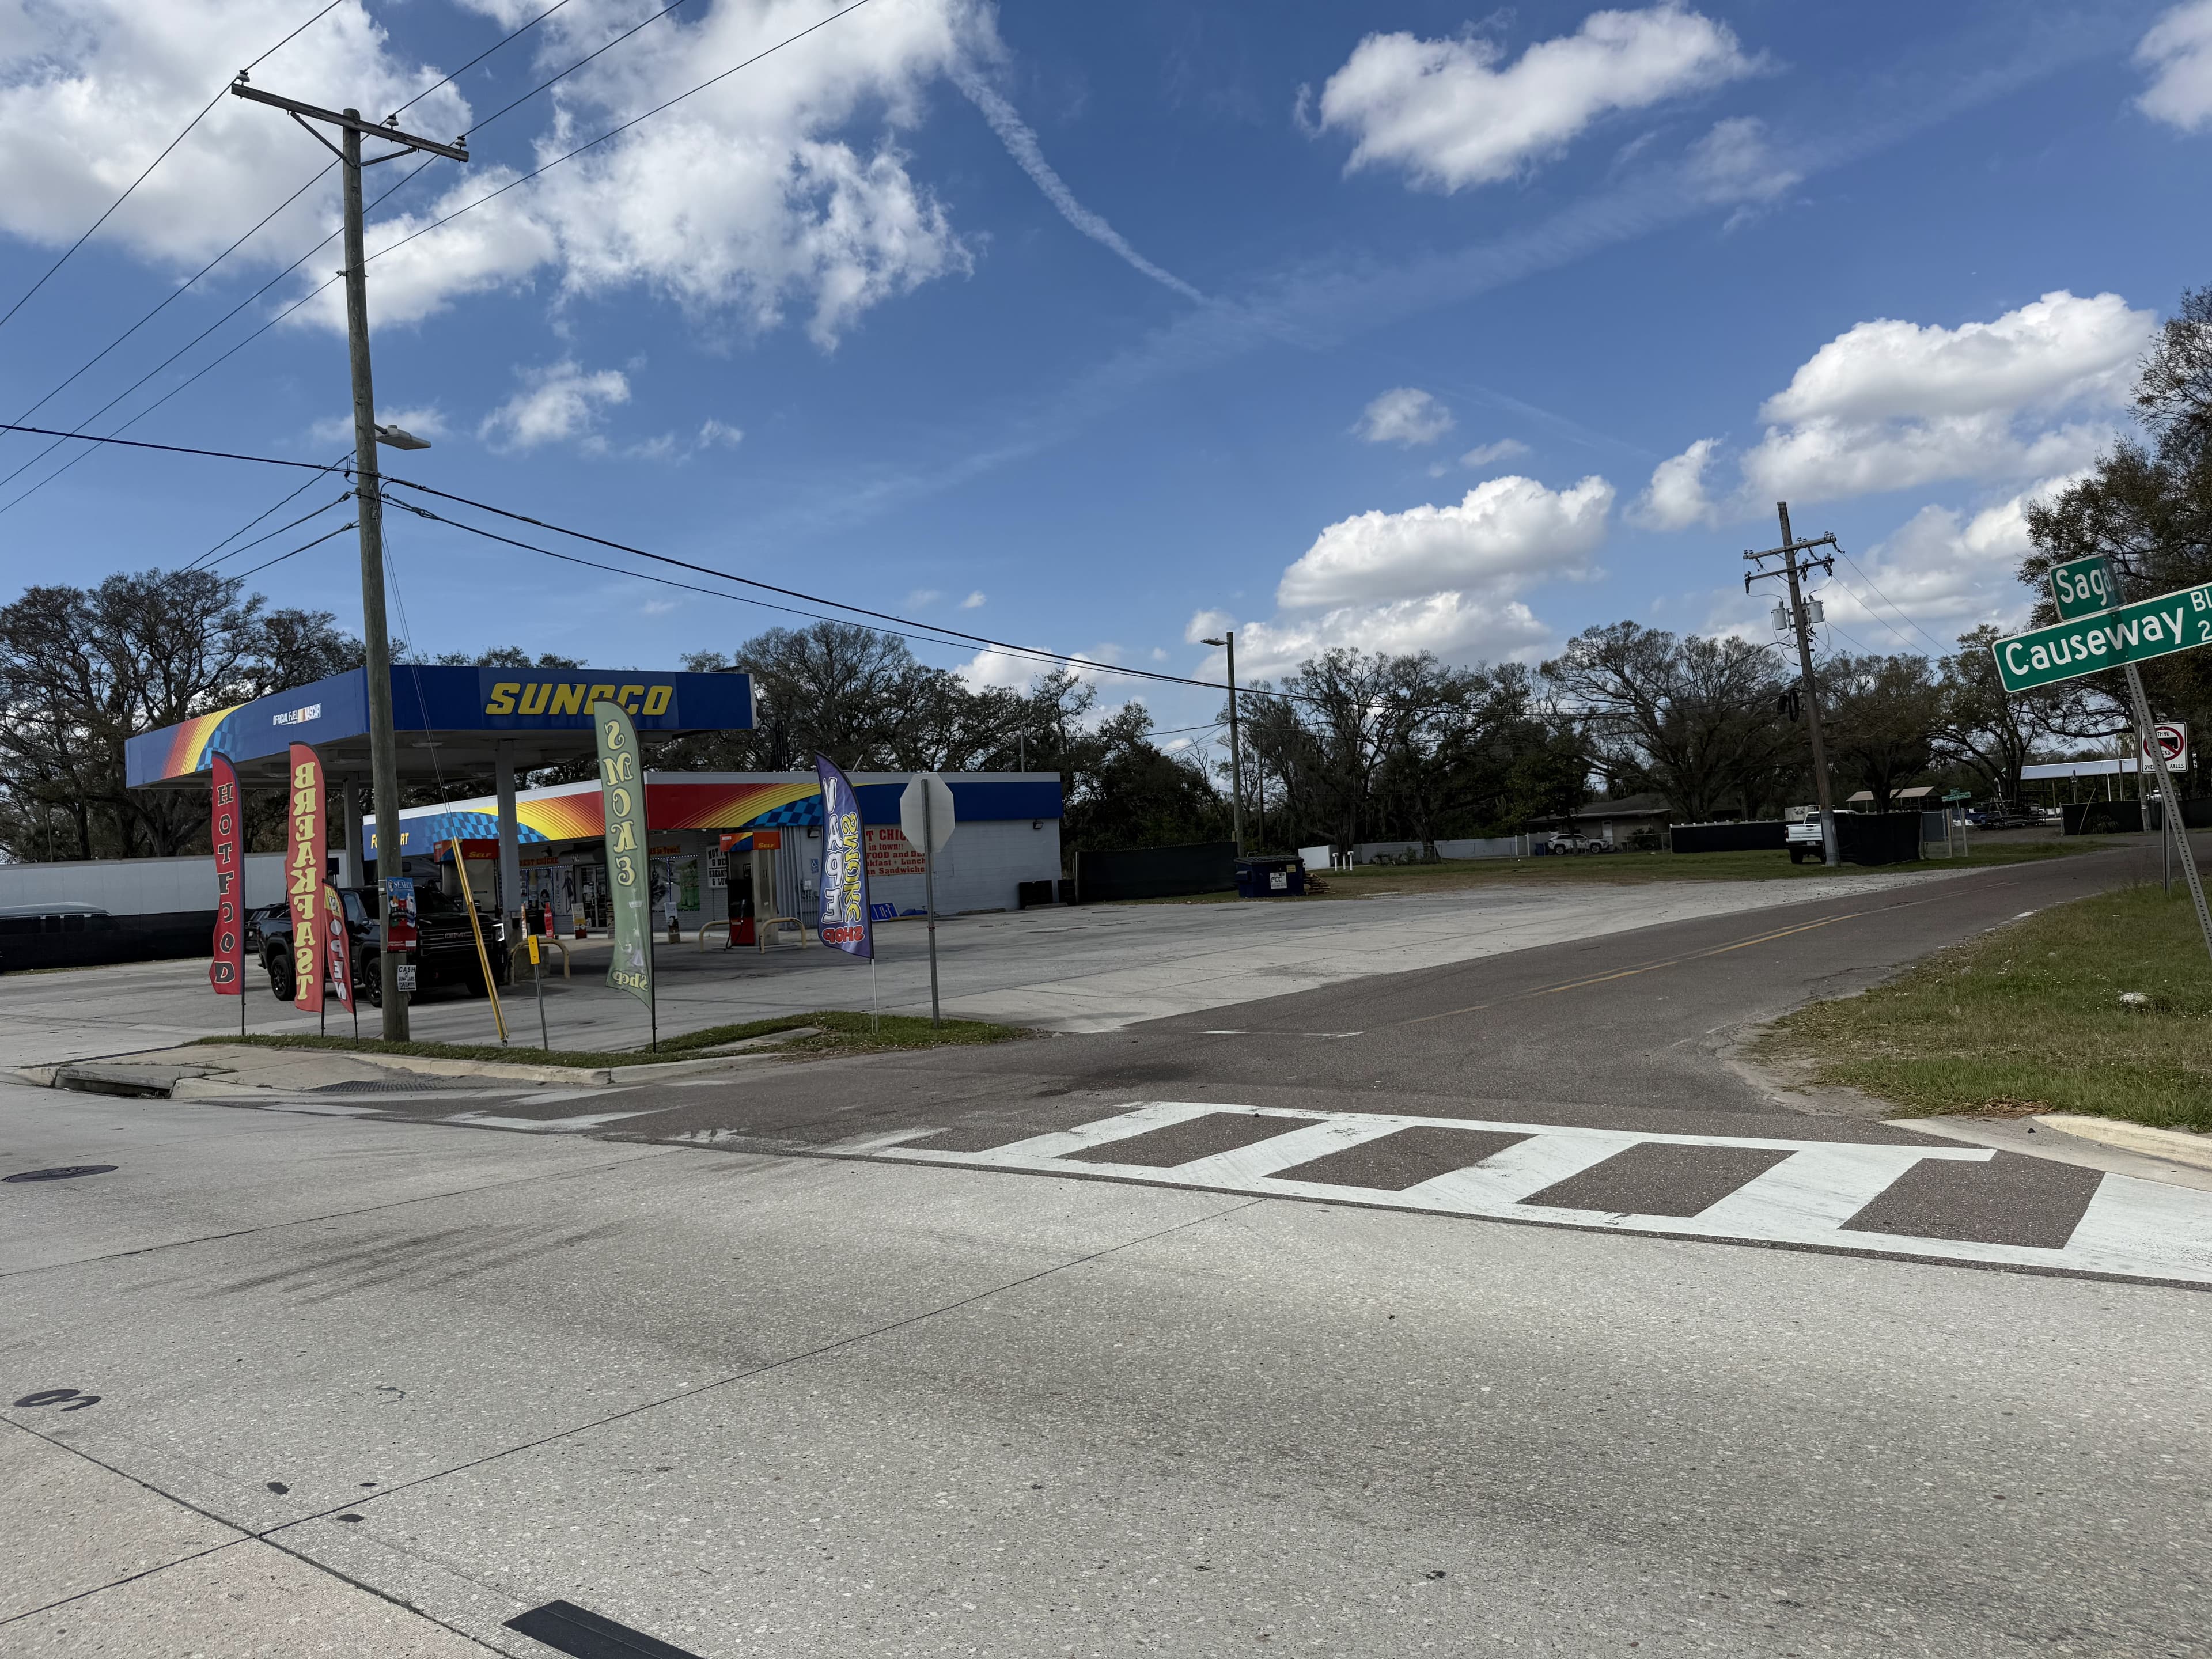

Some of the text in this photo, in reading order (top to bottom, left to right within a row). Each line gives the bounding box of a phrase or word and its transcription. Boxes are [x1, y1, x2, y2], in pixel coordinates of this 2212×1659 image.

[2190, 589, 2212, 612] BL
[2005, 608, 2183, 676] Causeway
[485, 683, 673, 715] SUNOCO
[305, 704, 320, 720] NASCAR
[217, 782, 234, 865] HOT
[880, 830, 908, 841] CHIC
[879, 866, 925, 874] Sandwiche
